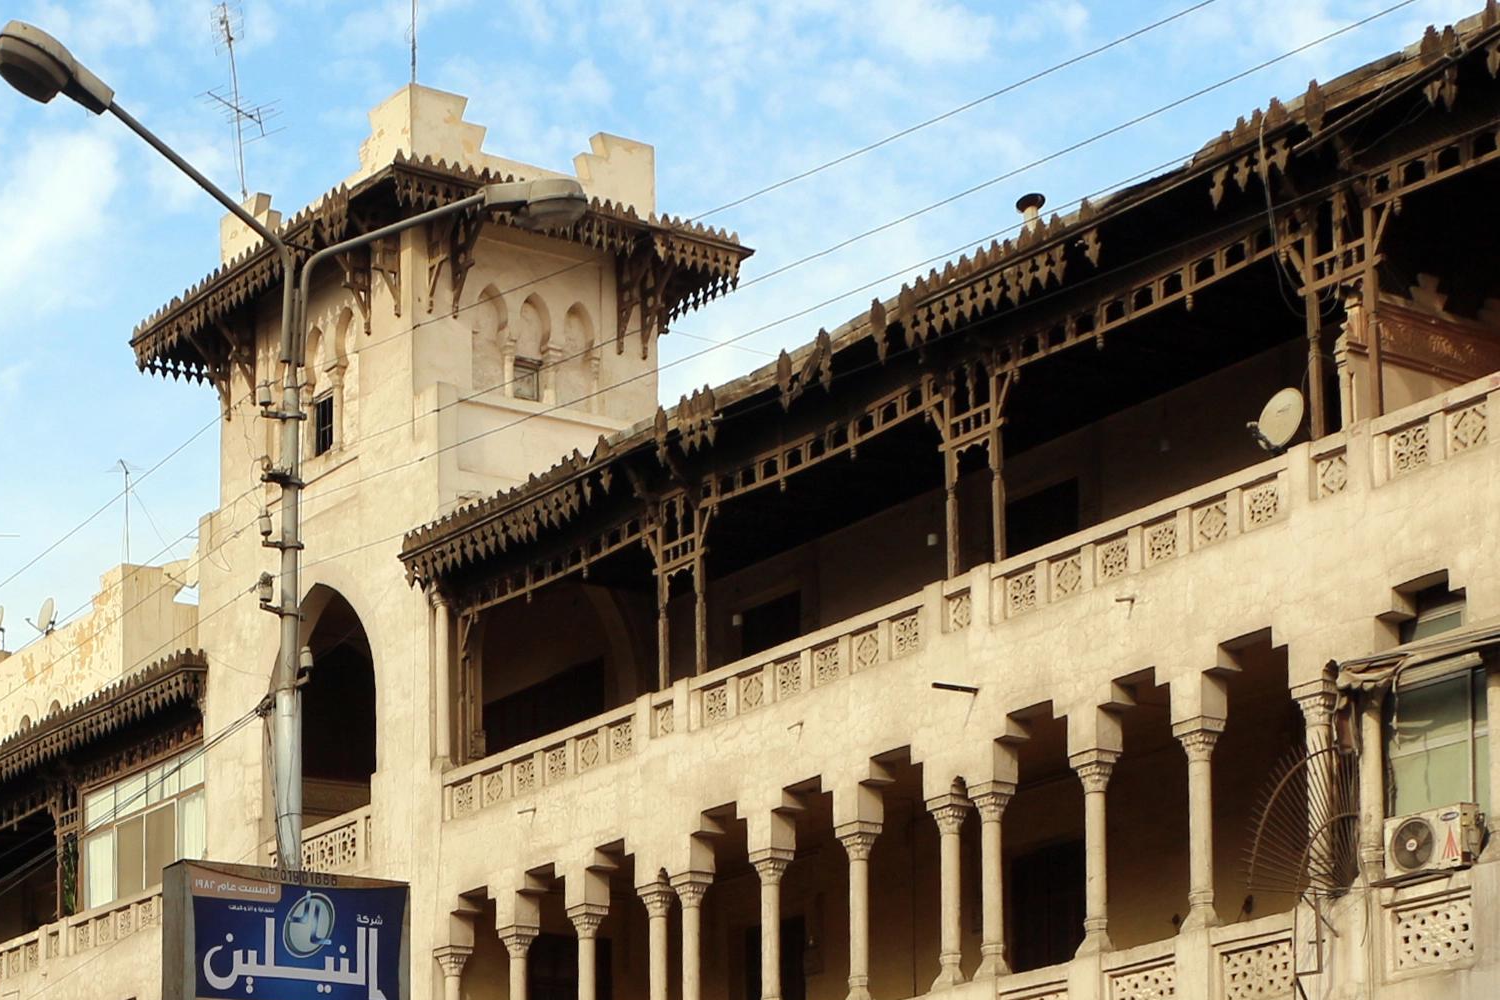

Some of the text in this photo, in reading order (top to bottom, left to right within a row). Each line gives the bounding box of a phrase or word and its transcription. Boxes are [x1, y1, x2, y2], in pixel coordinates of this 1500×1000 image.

[217, 882, 237, 892] عام
[238, 883, 277, 896] تأسست
[356, 914, 383, 926] شركة
